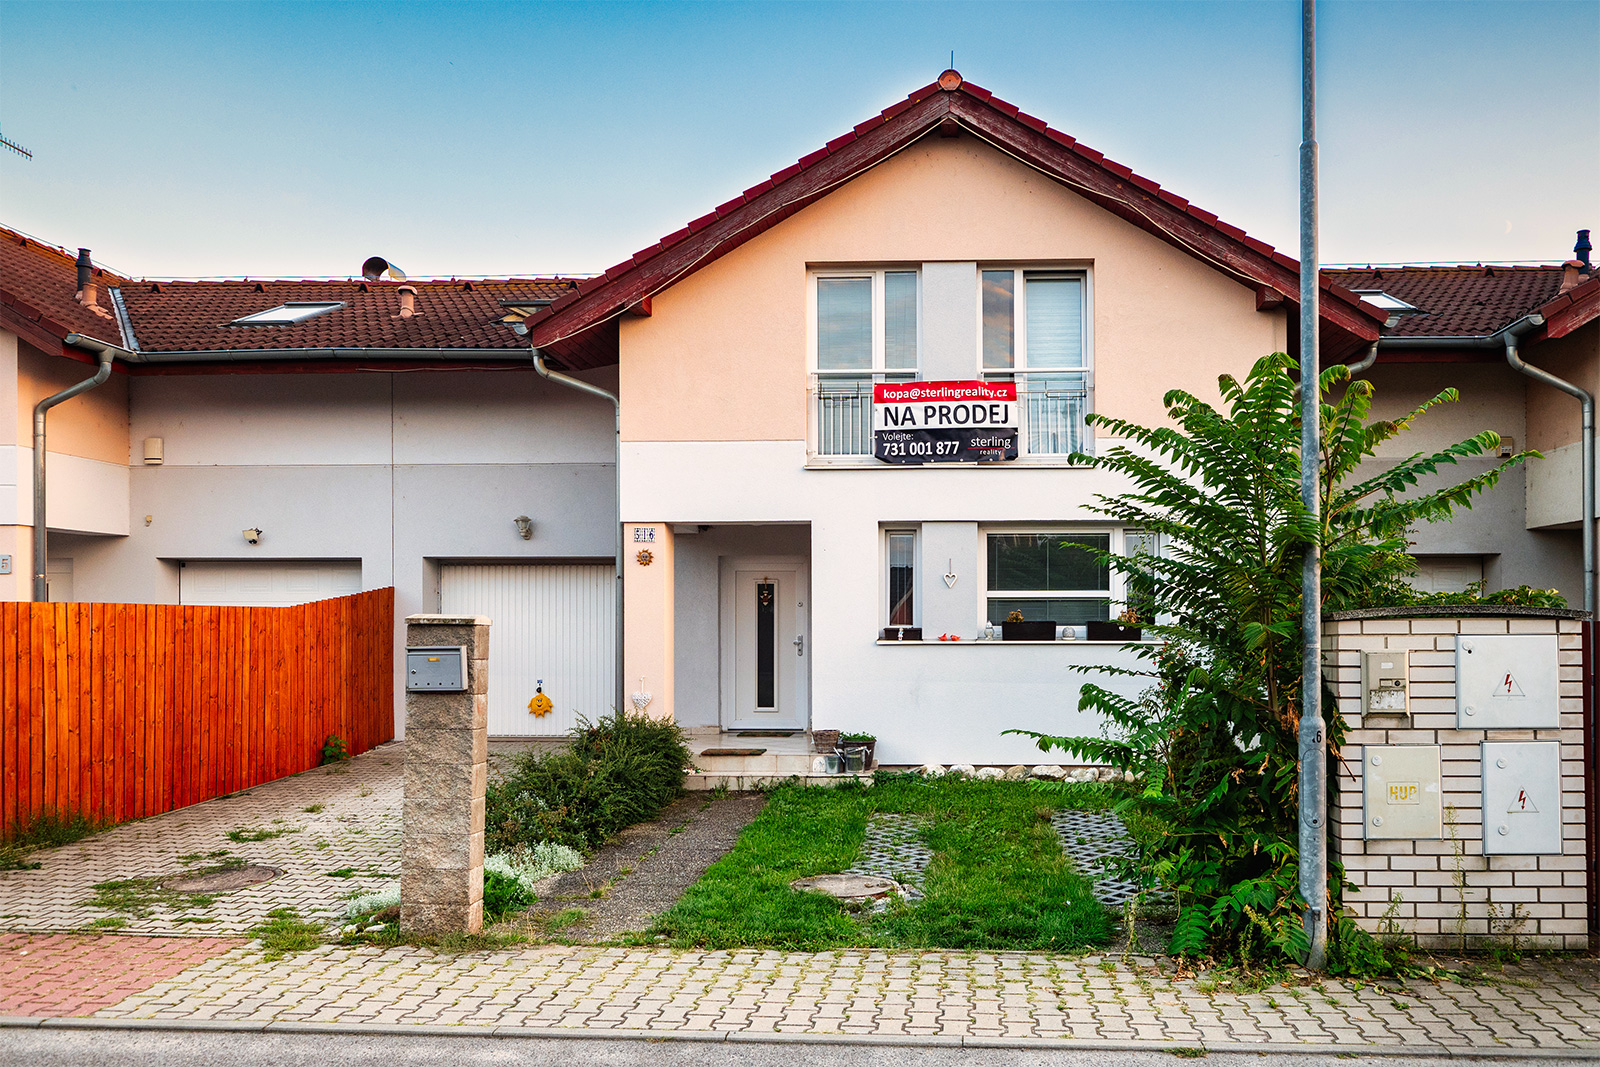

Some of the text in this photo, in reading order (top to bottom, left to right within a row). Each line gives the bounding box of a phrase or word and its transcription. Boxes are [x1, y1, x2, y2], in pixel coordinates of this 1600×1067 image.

[883, 386, 1008, 401] kopa@sterlingreality.cz
[884, 404, 1009, 426] NA PRODEJ
[882, 432, 914, 442] Volejte:
[970, 436, 1011, 449] sterling
[883, 441, 960, 456] 731 001 877
[1389, 785, 1417, 800] HUP
